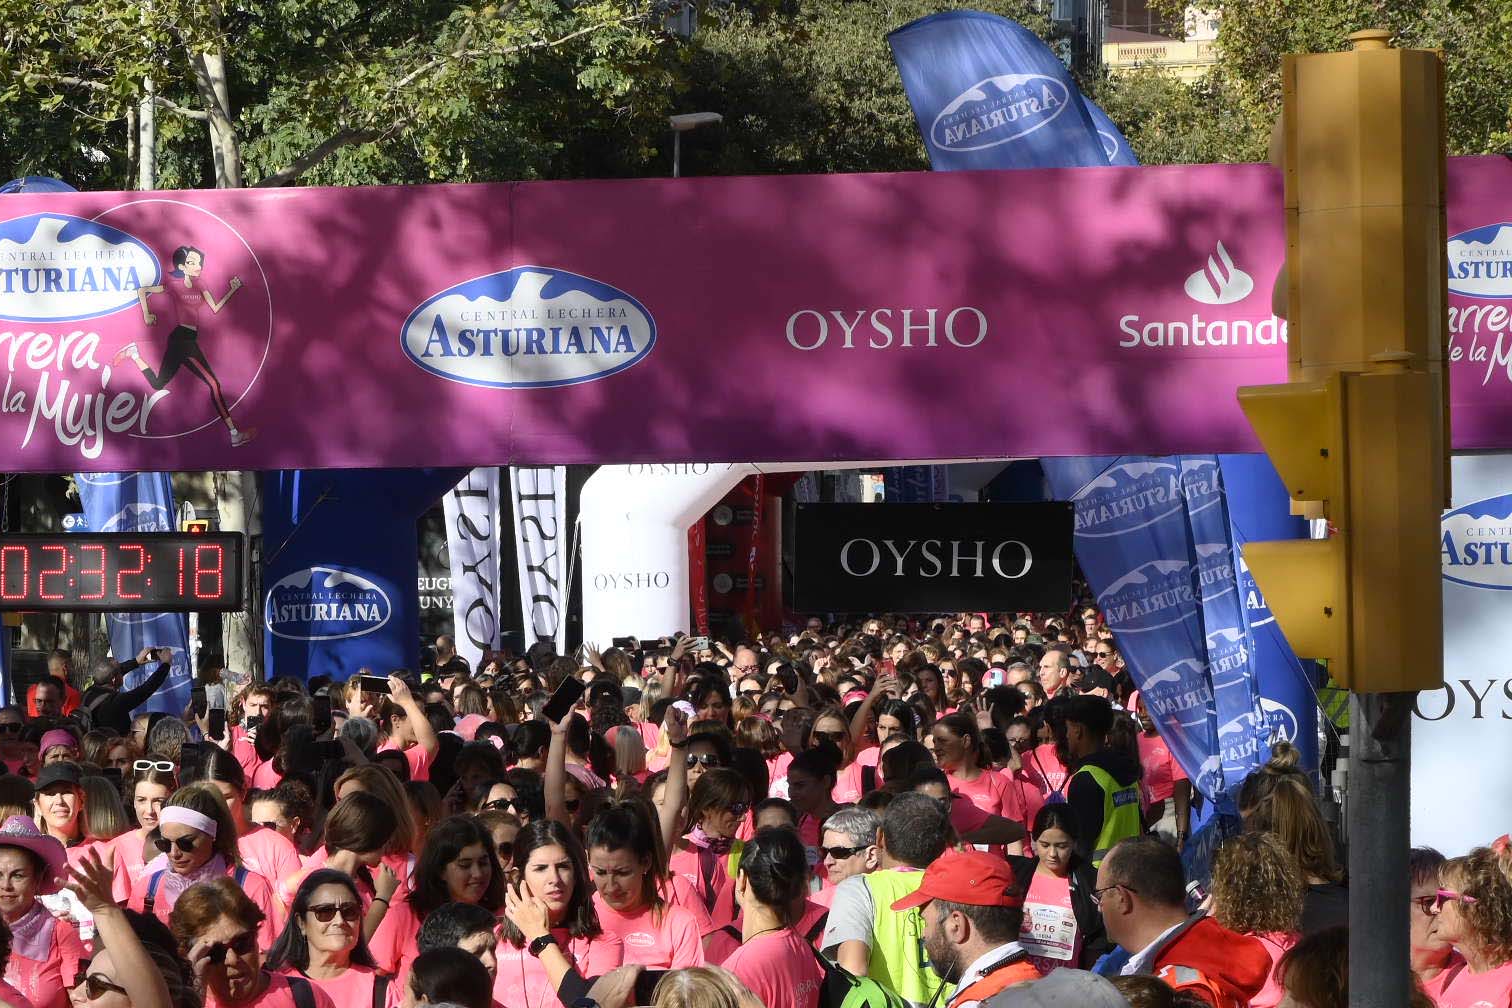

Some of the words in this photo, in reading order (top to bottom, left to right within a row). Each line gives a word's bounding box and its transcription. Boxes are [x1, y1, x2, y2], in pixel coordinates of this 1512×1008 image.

[63, 249, 136, 262] LECHERA
[460, 309, 539, 321] CENTRAL
[547, 307, 628, 319] LECHERA
[785, 306, 989, 350] OYSHO
[420, 312, 637, 360] ASTURIANA
[1119, 314, 1290, 348] Santand
[1469, 335, 1487, 362] la
[1, 373, 26, 413] la
[21, 365, 172, 460] Mujer
[0, 545, 224, 599] 02:32:18
[840, 538, 1033, 579] OYSHO
[328, 592, 377, 601] LECHERA
[593, 571, 670, 591] OYSHO
[270, 594, 383, 626] ASTURIANA
[419, 596, 454, 609] UNY
